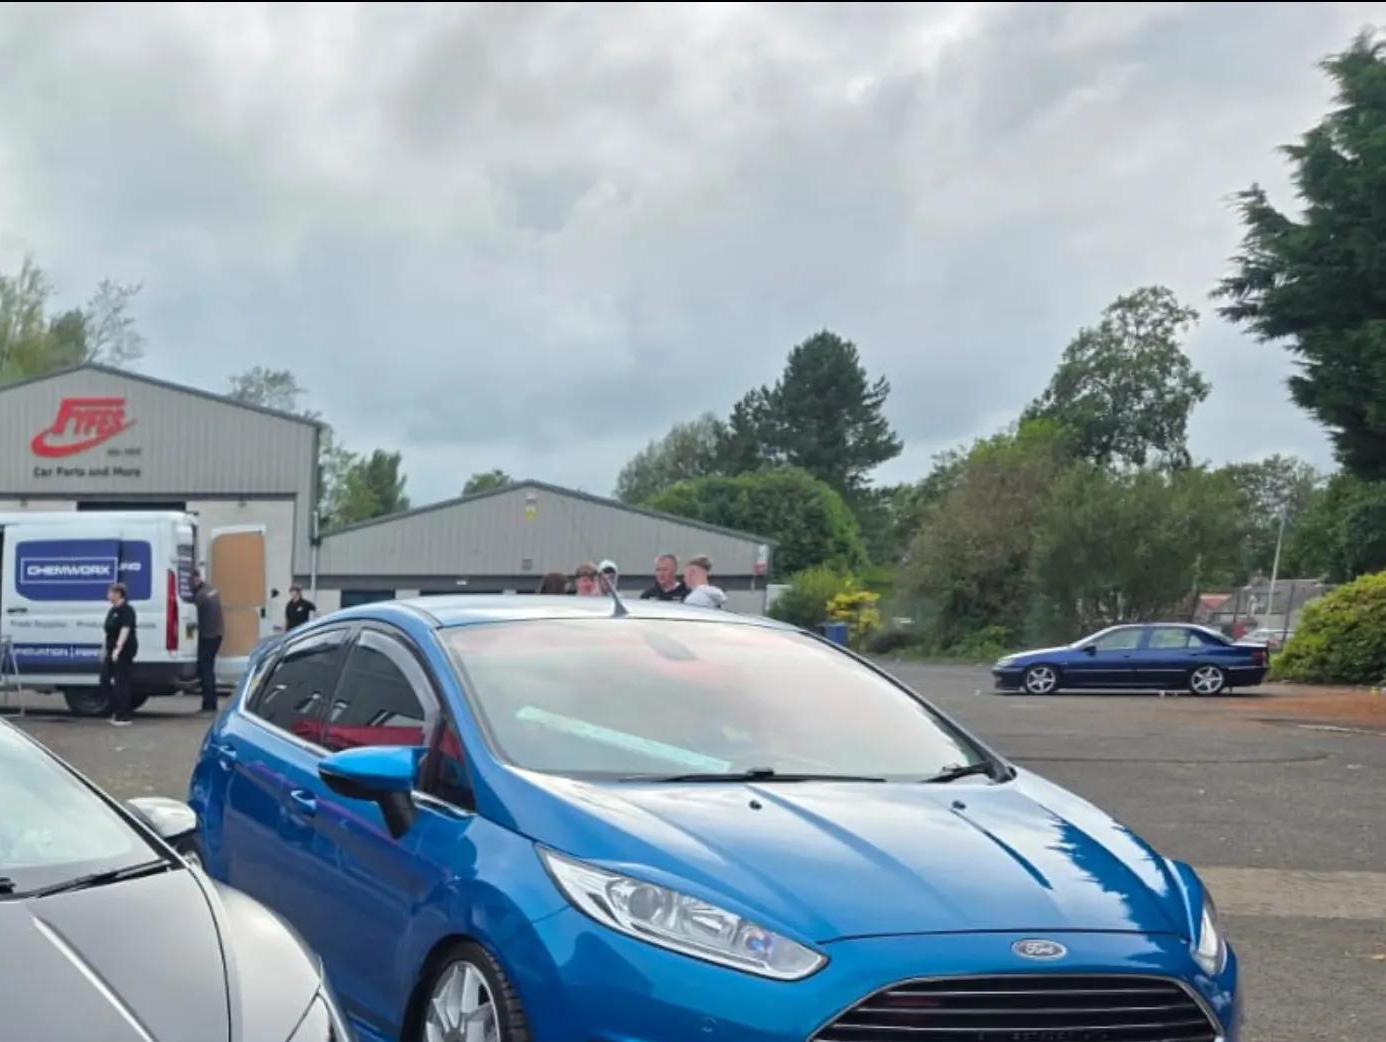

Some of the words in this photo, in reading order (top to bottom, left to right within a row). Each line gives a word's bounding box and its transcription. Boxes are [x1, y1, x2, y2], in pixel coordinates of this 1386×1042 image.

[33, 466, 52, 477] Car
[57, 466, 85, 477] Parts
[88, 466, 109, 477] and
[113, 466, 141, 477] More
[27, 562, 110, 576] CHEMWORX
